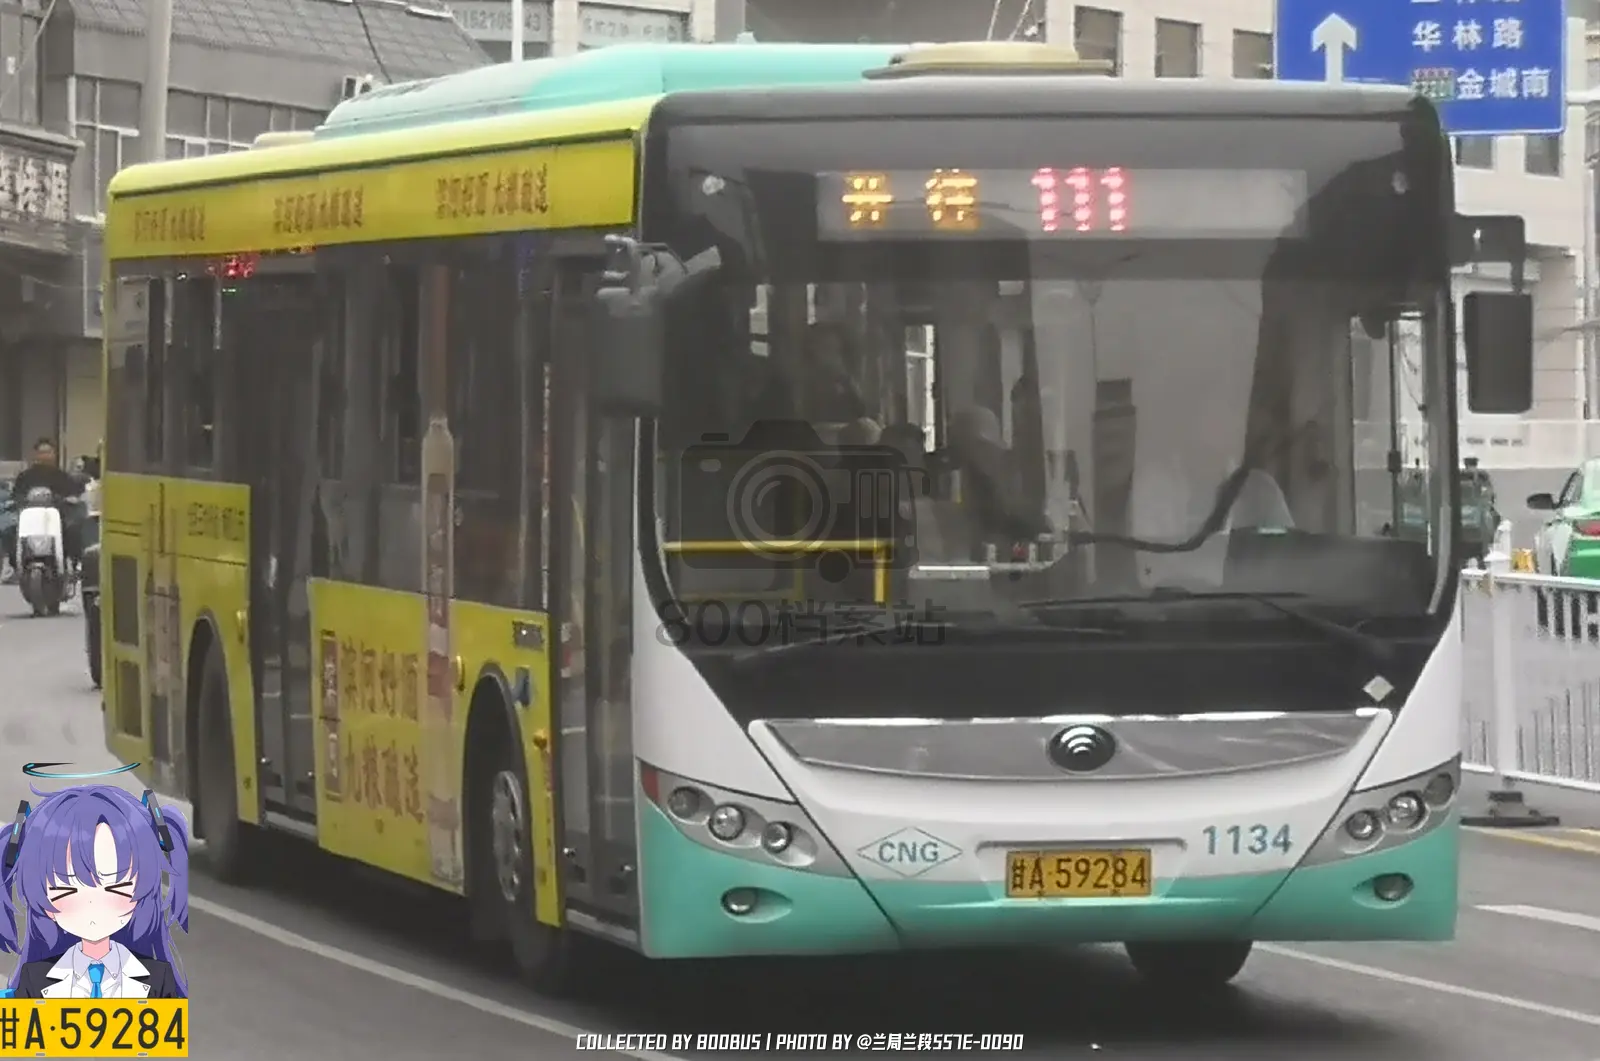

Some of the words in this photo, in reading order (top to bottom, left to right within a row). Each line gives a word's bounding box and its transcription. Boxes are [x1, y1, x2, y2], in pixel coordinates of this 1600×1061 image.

[1411, 18, 1523, 51] 华林路
[1456, 67, 1551, 99] 金城南
[1031, 167, 1130, 231] 111
[878, 841, 940, 863] CNG
[1202, 823, 1294, 856] 1134
